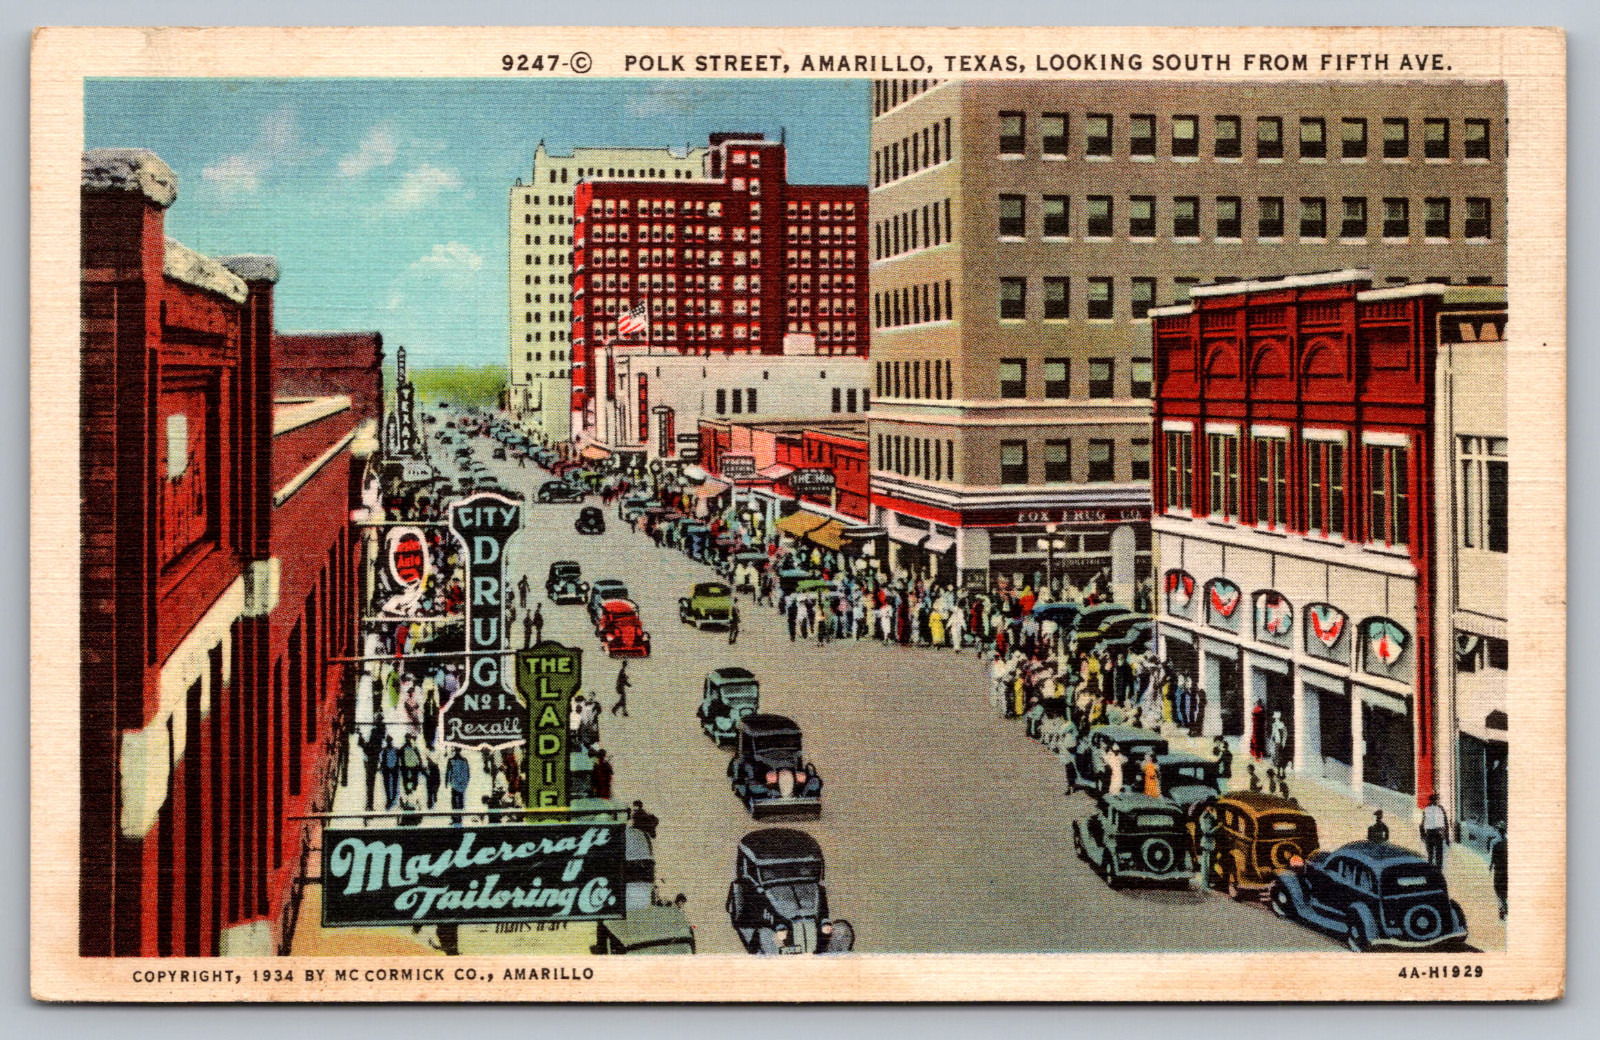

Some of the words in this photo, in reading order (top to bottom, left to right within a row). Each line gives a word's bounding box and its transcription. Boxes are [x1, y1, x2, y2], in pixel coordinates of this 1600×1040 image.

[625, 54, 684, 72] POLK
[696, 54, 790, 74] STREET,
[801, 54, 933, 74] AMARILLO,
[945, 54, 1026, 73] TEXAS,
[1037, 53, 1142, 71] LOOKING
[1153, 53, 1230, 71] SOUTH
[1245, 54, 1308, 71] FROM
[1321, 53, 1388, 71] FIFTH
[1400, 53, 1452, 71] AVE.
[458, 508, 517, 527] CITY
[473, 537, 499, 686] DRUG
[526, 657, 571, 674] THE
[446, 717, 522, 740] Rexall
[330, 827, 610, 896] Mastercraft
[394, 874, 579, 919] Tailoring
[578, 876, 618, 915] Co.
[133, 969, 242, 985] COPYRIGHT,
[254, 970, 293, 982] 1934
[305, 969, 324, 982] BY
[455, 968, 494, 983] CO.,
[503, 967, 594, 981] AMARILLO
[1398, 966, 1485, 979] 4A-H1929
